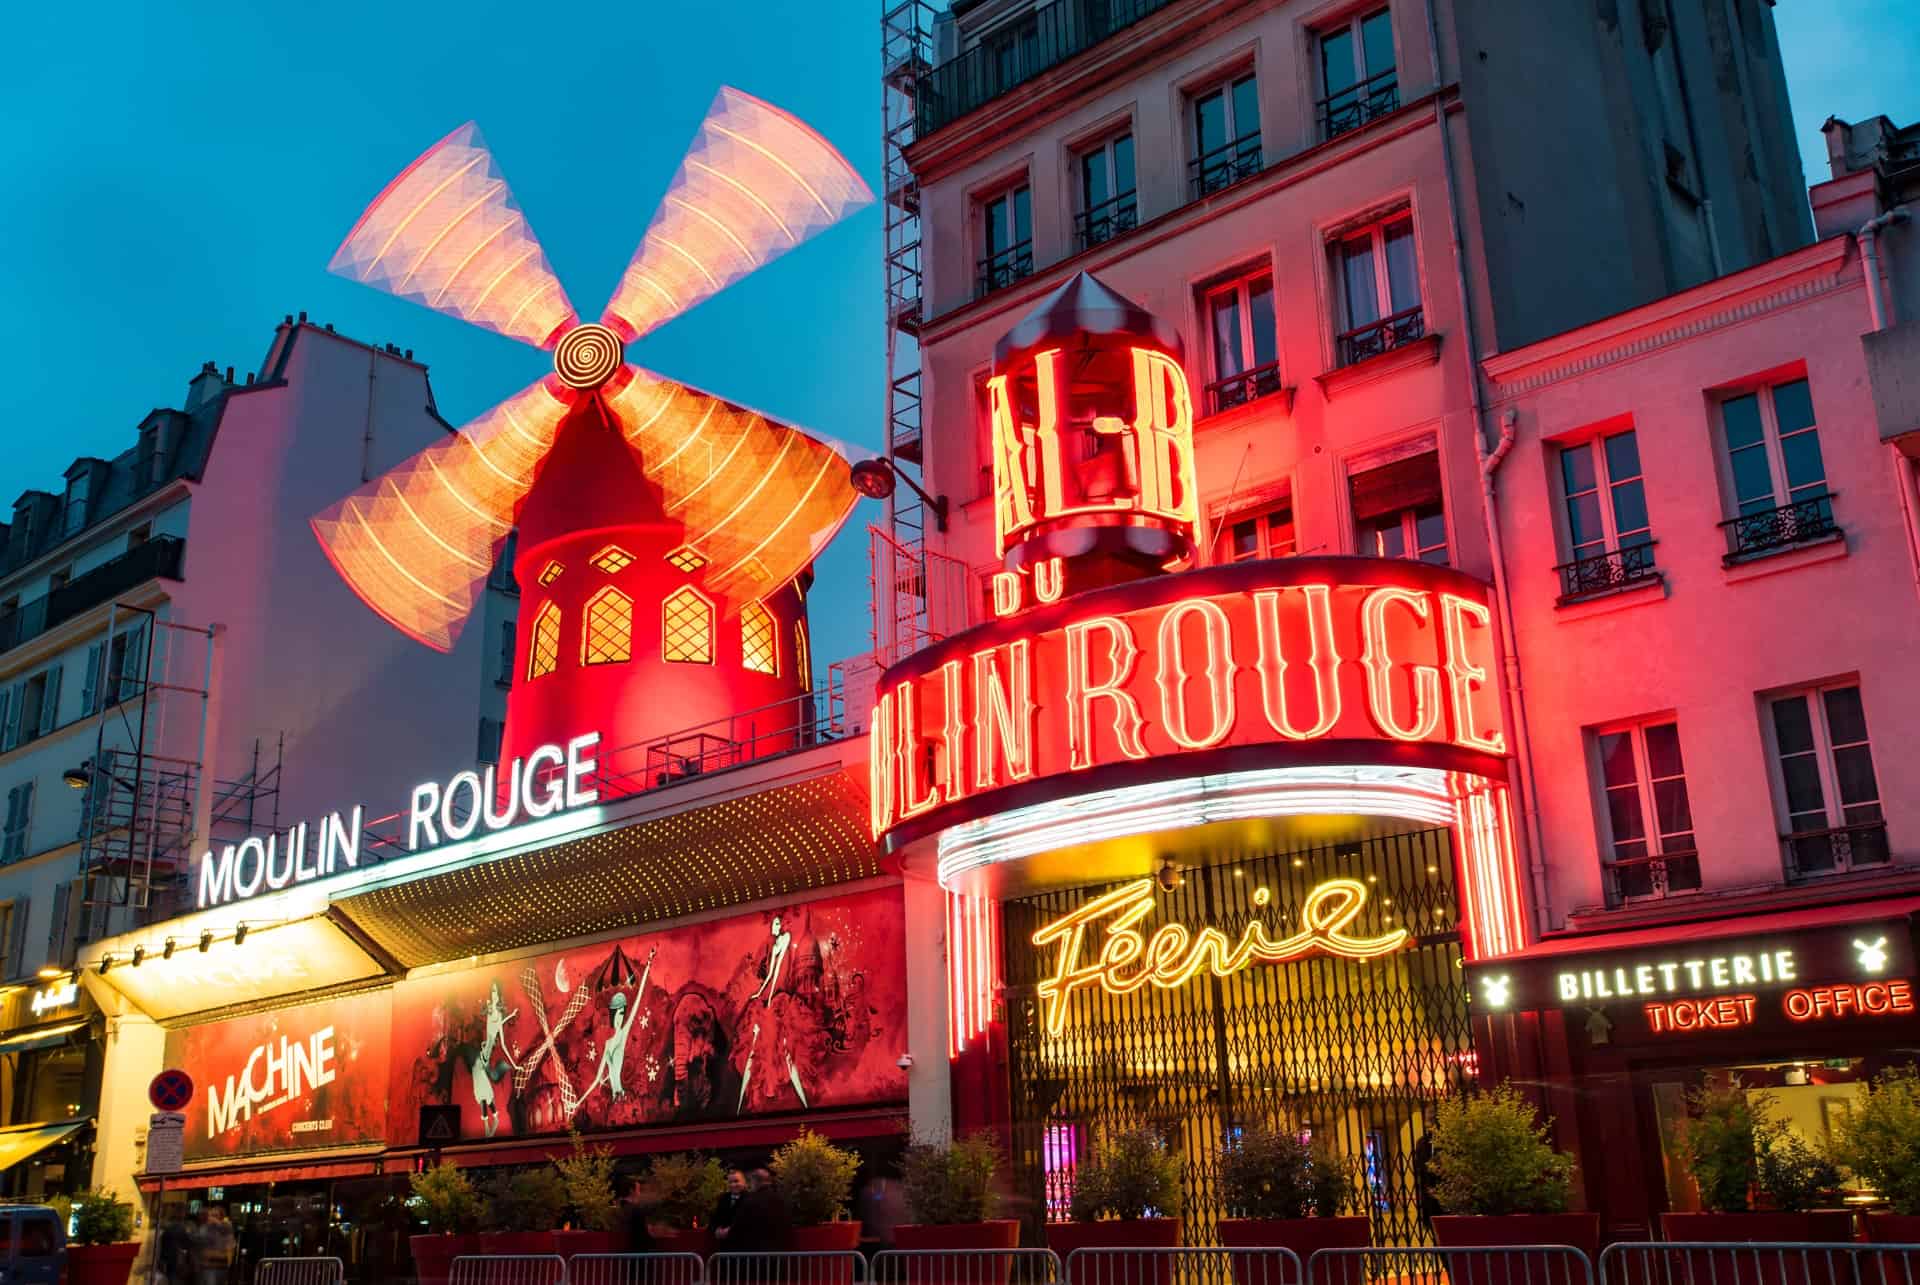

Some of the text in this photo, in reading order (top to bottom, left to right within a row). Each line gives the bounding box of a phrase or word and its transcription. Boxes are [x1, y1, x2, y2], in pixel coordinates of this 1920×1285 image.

[993, 557, 1064, 616] DU
[1067, 584, 1505, 771] ROUGE
[197, 732, 601, 907] MOULIN ROUGE
[1559, 951, 1796, 1001] BILLETTERIE
[1645, 981, 1913, 1032] TICKET OFFICE
[207, 1024, 336, 1139] MACHINE
